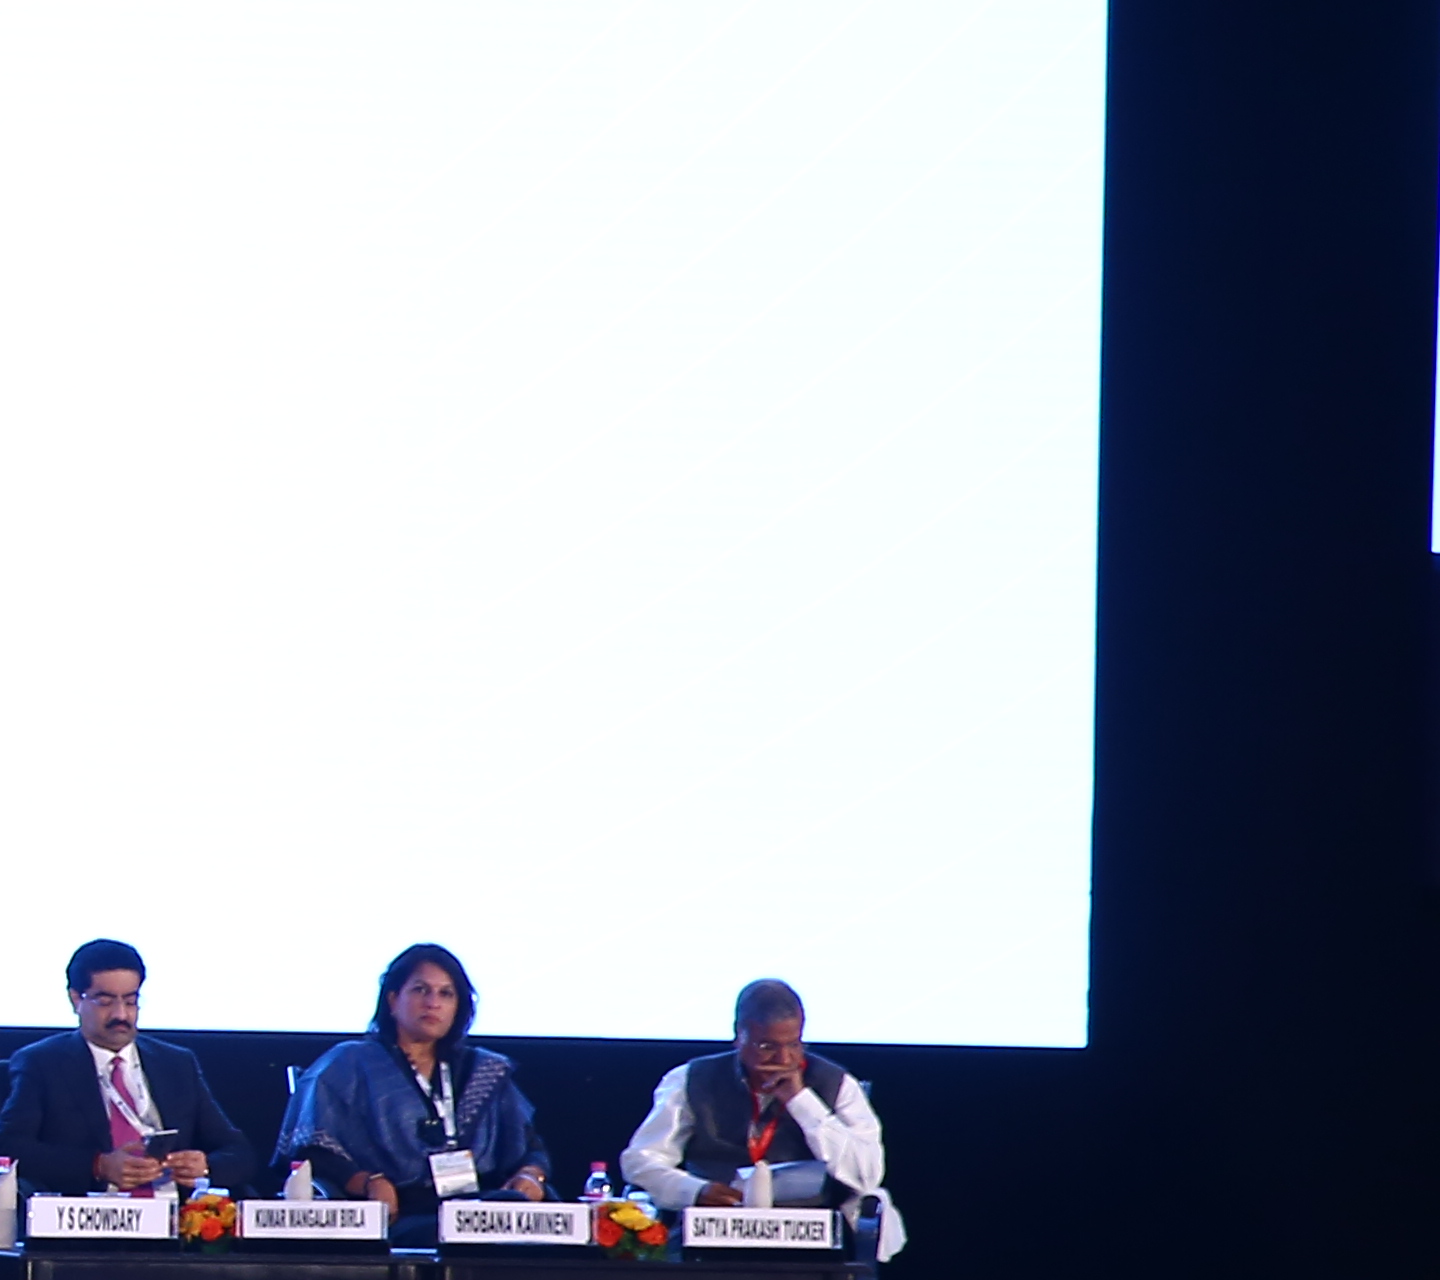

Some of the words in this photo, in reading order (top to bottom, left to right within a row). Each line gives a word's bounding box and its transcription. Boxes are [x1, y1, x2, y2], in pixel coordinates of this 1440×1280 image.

[57, 1206, 65, 1230] Y
[67, 1206, 75, 1231] S
[78, 1207, 142, 1232] CHOWDARY
[455, 1209, 513, 1234] SHOBANA
[516, 1211, 574, 1236] KAMINENI
[693, 1216, 727, 1238] SATYA
[729, 1217, 781, 1239] PRAKASH
[783, 1219, 826, 1241] TUCKER
